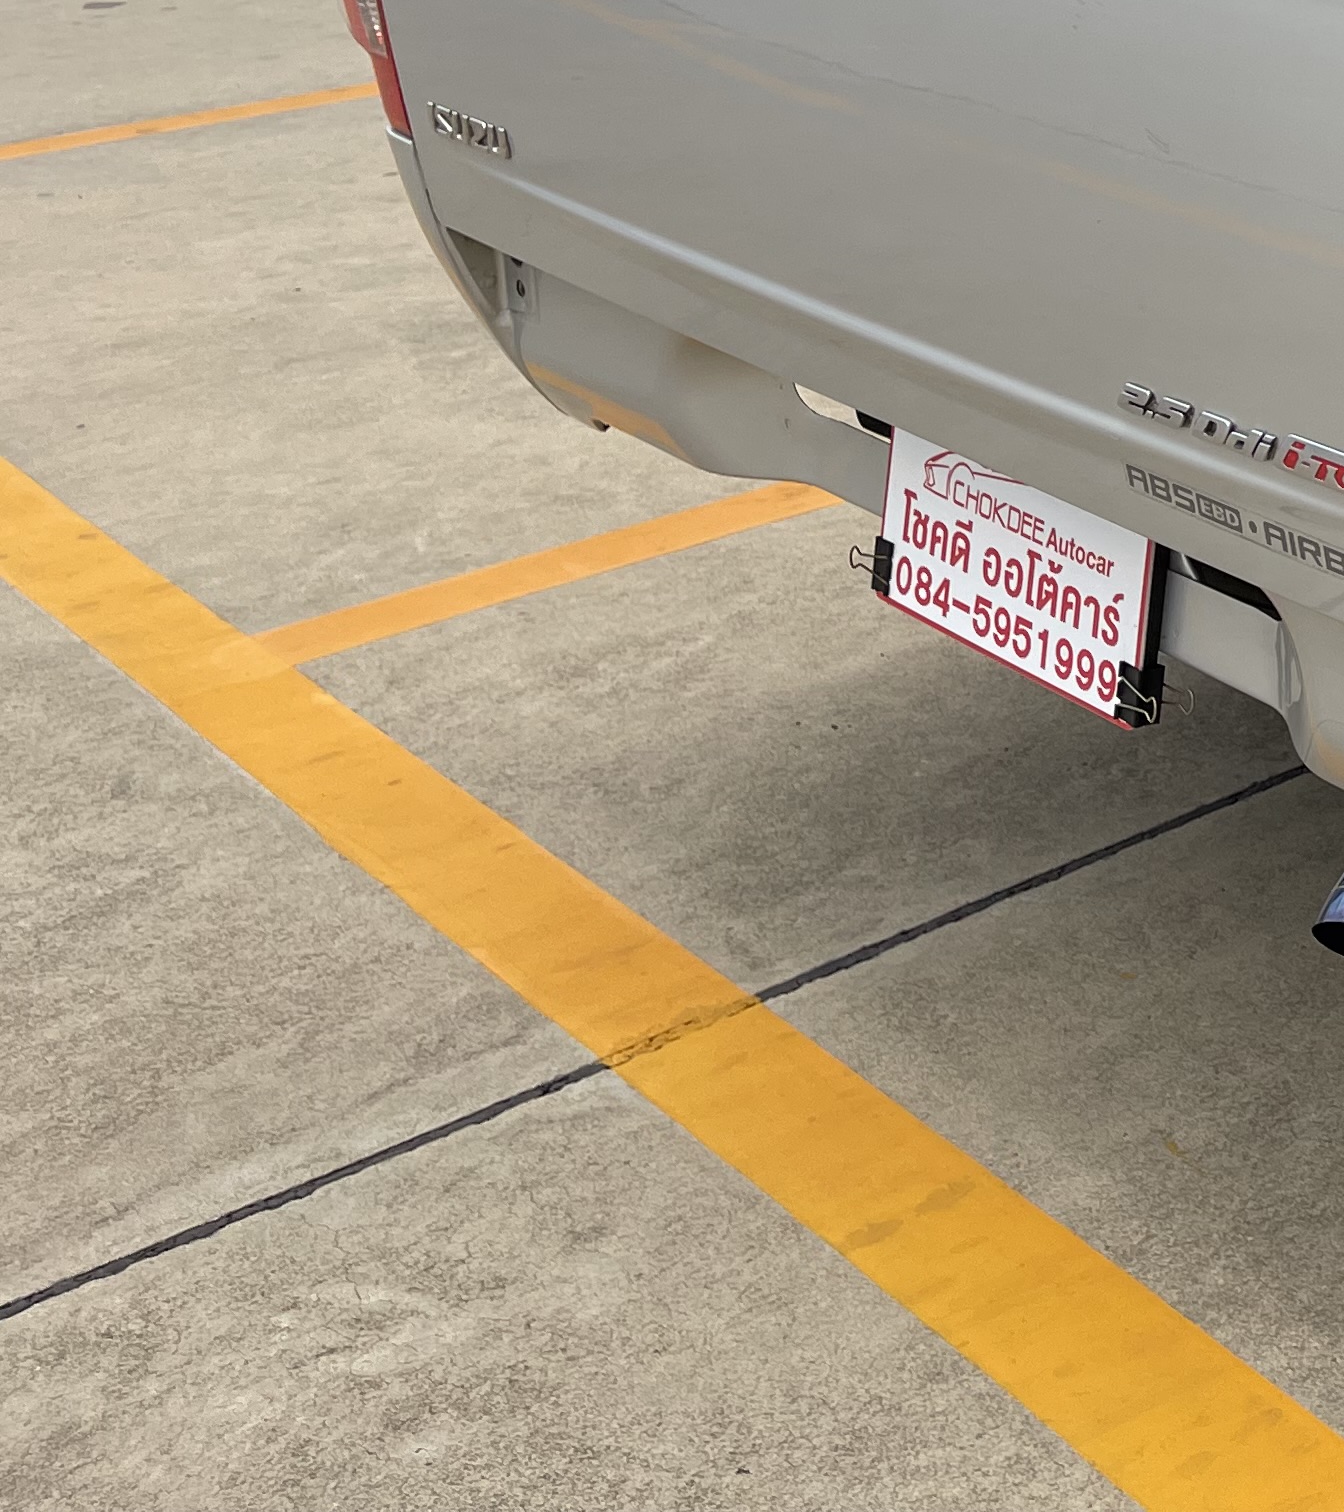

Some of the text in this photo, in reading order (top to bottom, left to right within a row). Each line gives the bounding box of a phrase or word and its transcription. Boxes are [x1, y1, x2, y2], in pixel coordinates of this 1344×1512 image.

[1117, 381, 1195, 429] 2.5
[953, 479, 1114, 577] CHOKDEE Autocar
[1125, 463, 1196, 514] ABS
[902, 488, 1125, 647] โชคดี ออโต้คาร์
[896, 556, 1117, 703] 084-5951999
